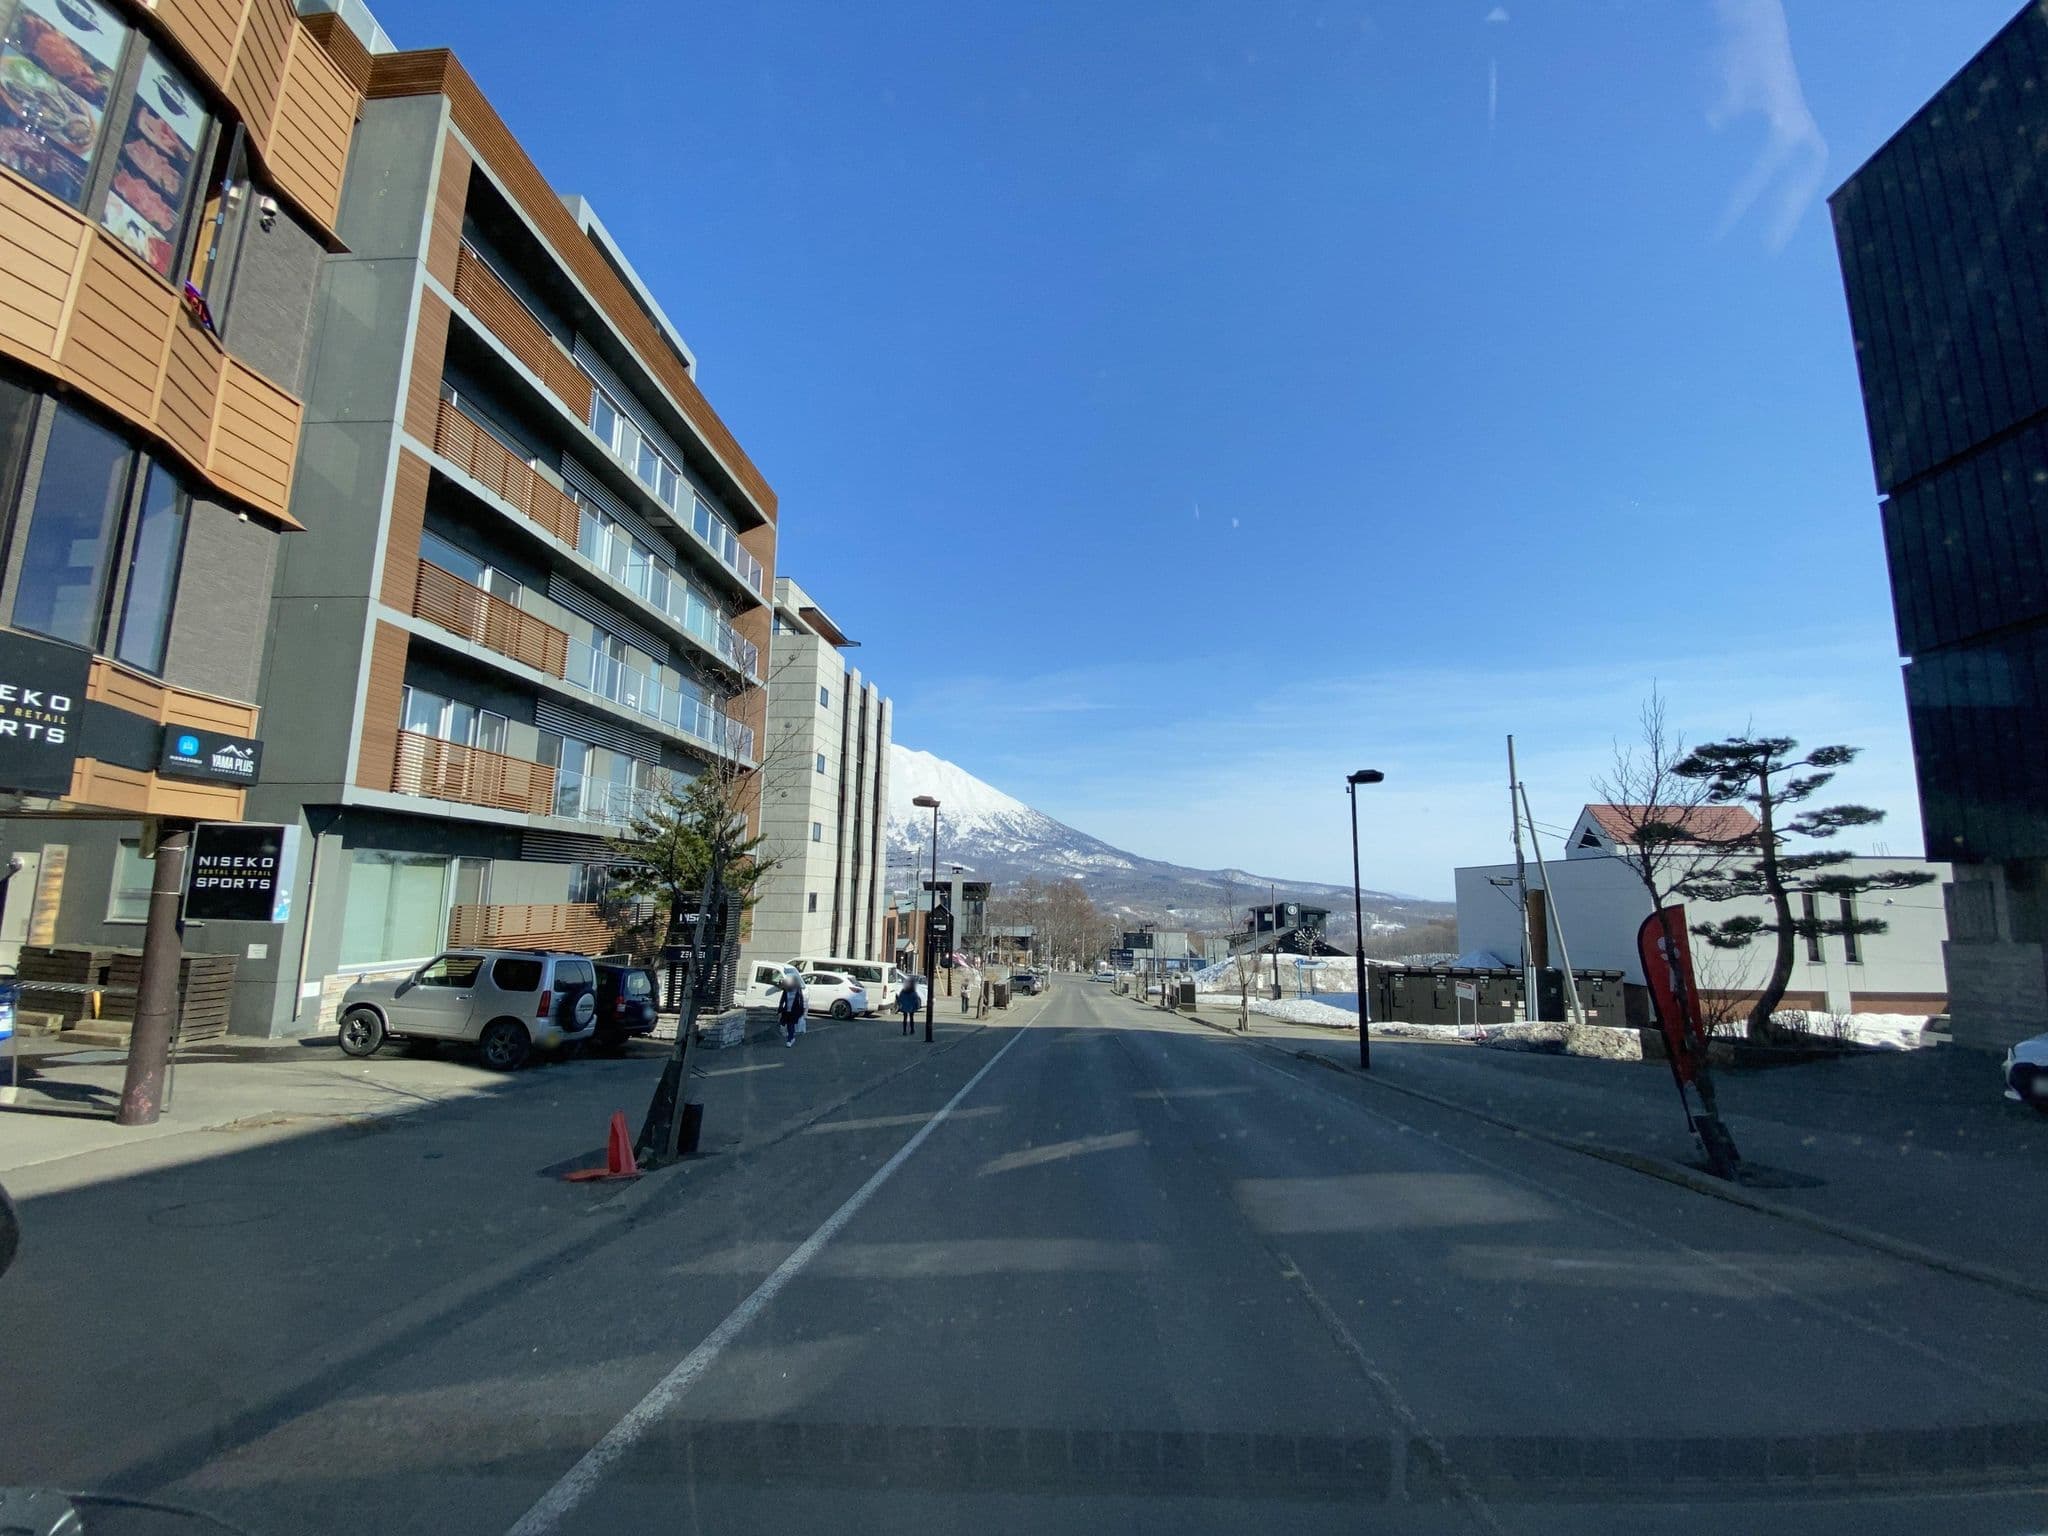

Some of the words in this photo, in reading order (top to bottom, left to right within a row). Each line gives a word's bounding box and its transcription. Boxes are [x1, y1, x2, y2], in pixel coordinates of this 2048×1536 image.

[14, 707, 68, 725] RETAIL
[211, 753, 234, 770] YAMA
[234, 758, 255, 773] PLUS
[199, 855, 274, 868] NISEKO
[195, 877, 271, 889] SPORTS
